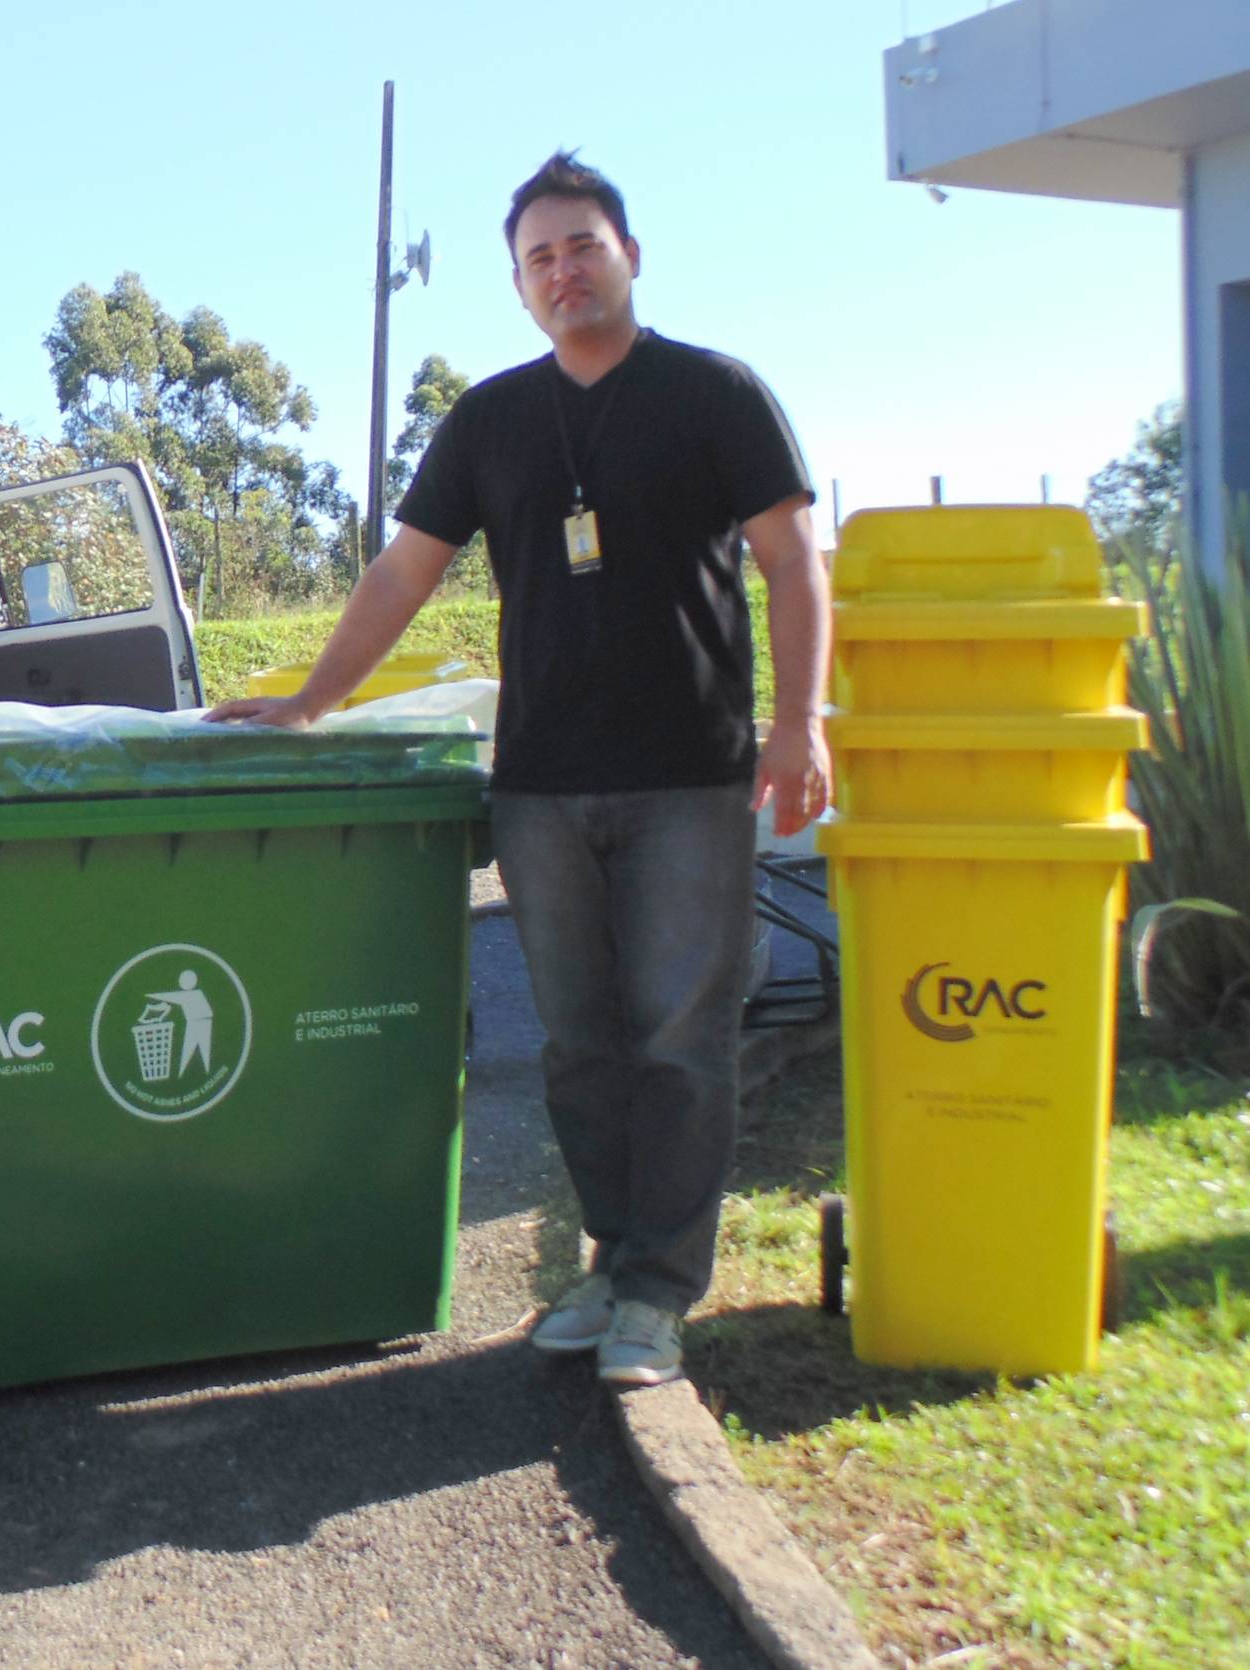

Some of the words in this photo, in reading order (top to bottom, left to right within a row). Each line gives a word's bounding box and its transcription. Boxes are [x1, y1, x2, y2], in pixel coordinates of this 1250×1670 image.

[295, 1008, 348, 1024] ATERRO
[295, 1028, 303, 1041] E
[307, 1023, 381, 1039] INDUSTRIAL
